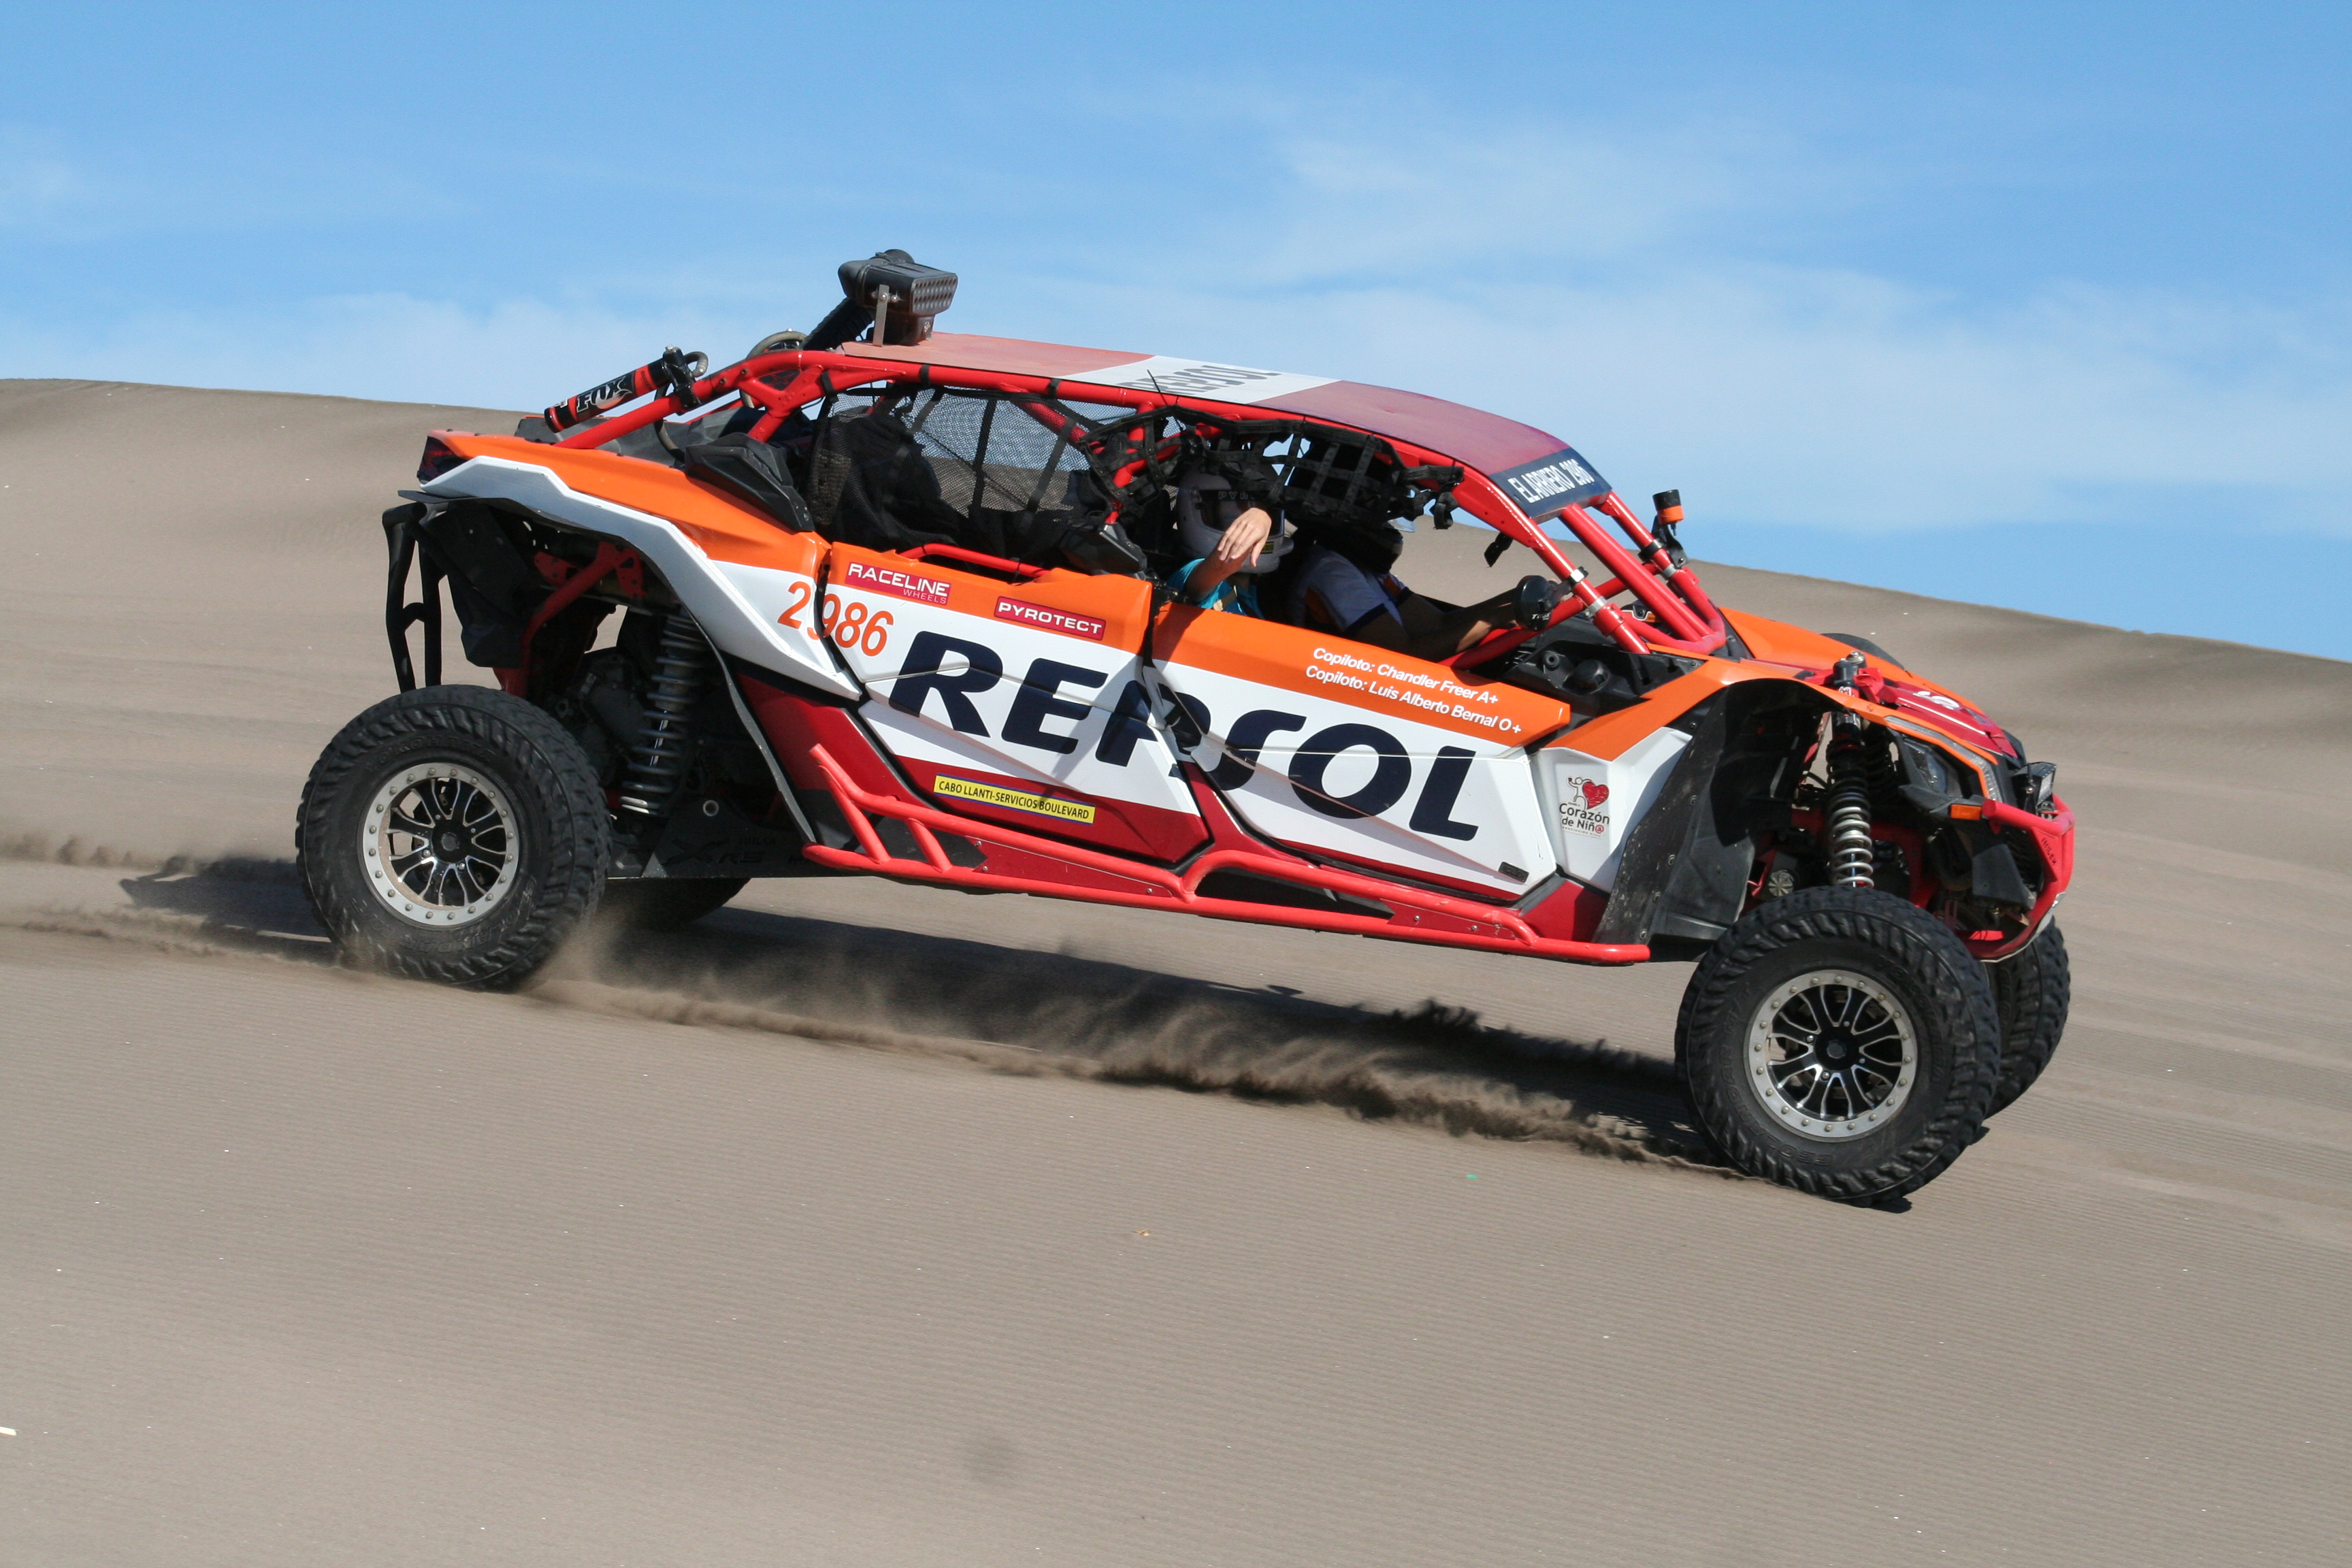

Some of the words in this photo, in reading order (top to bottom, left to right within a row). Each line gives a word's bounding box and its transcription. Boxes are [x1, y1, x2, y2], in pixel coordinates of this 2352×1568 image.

[576, 376, 632, 412] FOX
[1507, 477, 1541, 503] EL
[1521, 465, 1575, 499] ARRIERO
[848, 563, 950, 597] RACELINE
[903, 589, 947, 604] WHEELS
[777, 581, 894, 657] 2986
[998, 602, 1102, 634] PYROTECT
[1313, 647, 1375, 672] Copiloto:
[1377, 664, 1441, 689] Chandler
[1439, 680, 1479, 700] Freer
[1477, 690, 1499, 704] A+
[1305, 665, 1368, 691] Copiloto:
[1368, 681, 1399, 700] Luis
[1399, 690, 1450, 715] Alberto
[1450, 704, 1498, 728] Bernal
[889, 630, 1479, 841] REPSOL
[938, 781, 962, 794] CABO
[963, 785, 1038, 808] LLANTI-SERVICIOS
[1039, 801, 1090, 819] BOULEVARD
[1559, 803, 1610, 825] Corazón
[1561, 817, 1574, 827] de
[1577, 819, 1605, 834] Niñ@
